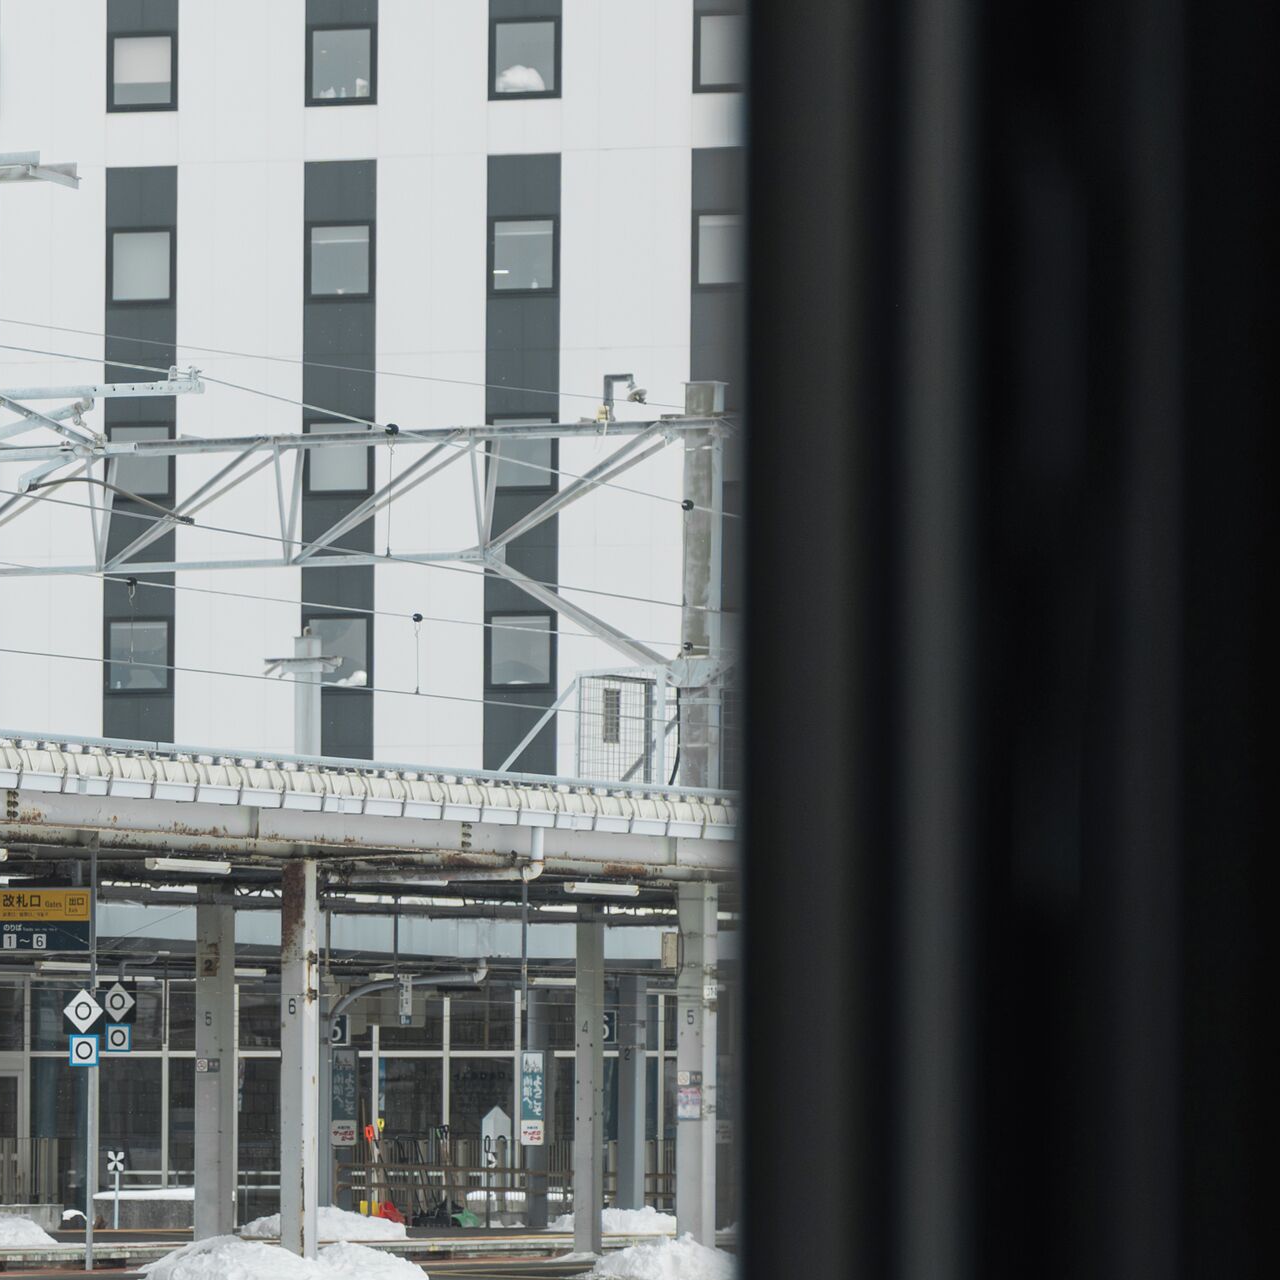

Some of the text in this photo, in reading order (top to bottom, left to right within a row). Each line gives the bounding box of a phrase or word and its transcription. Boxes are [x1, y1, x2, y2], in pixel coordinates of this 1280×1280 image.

[2, 894, 41, 908] 改札口
[68, 897, 85, 906] 出口
[3, 924, 23, 932] のりば
[288, 998, 297, 1015] 6
[686, 1009, 695, 1025] 5
[533, 1075, 543, 1116] ようこそ
